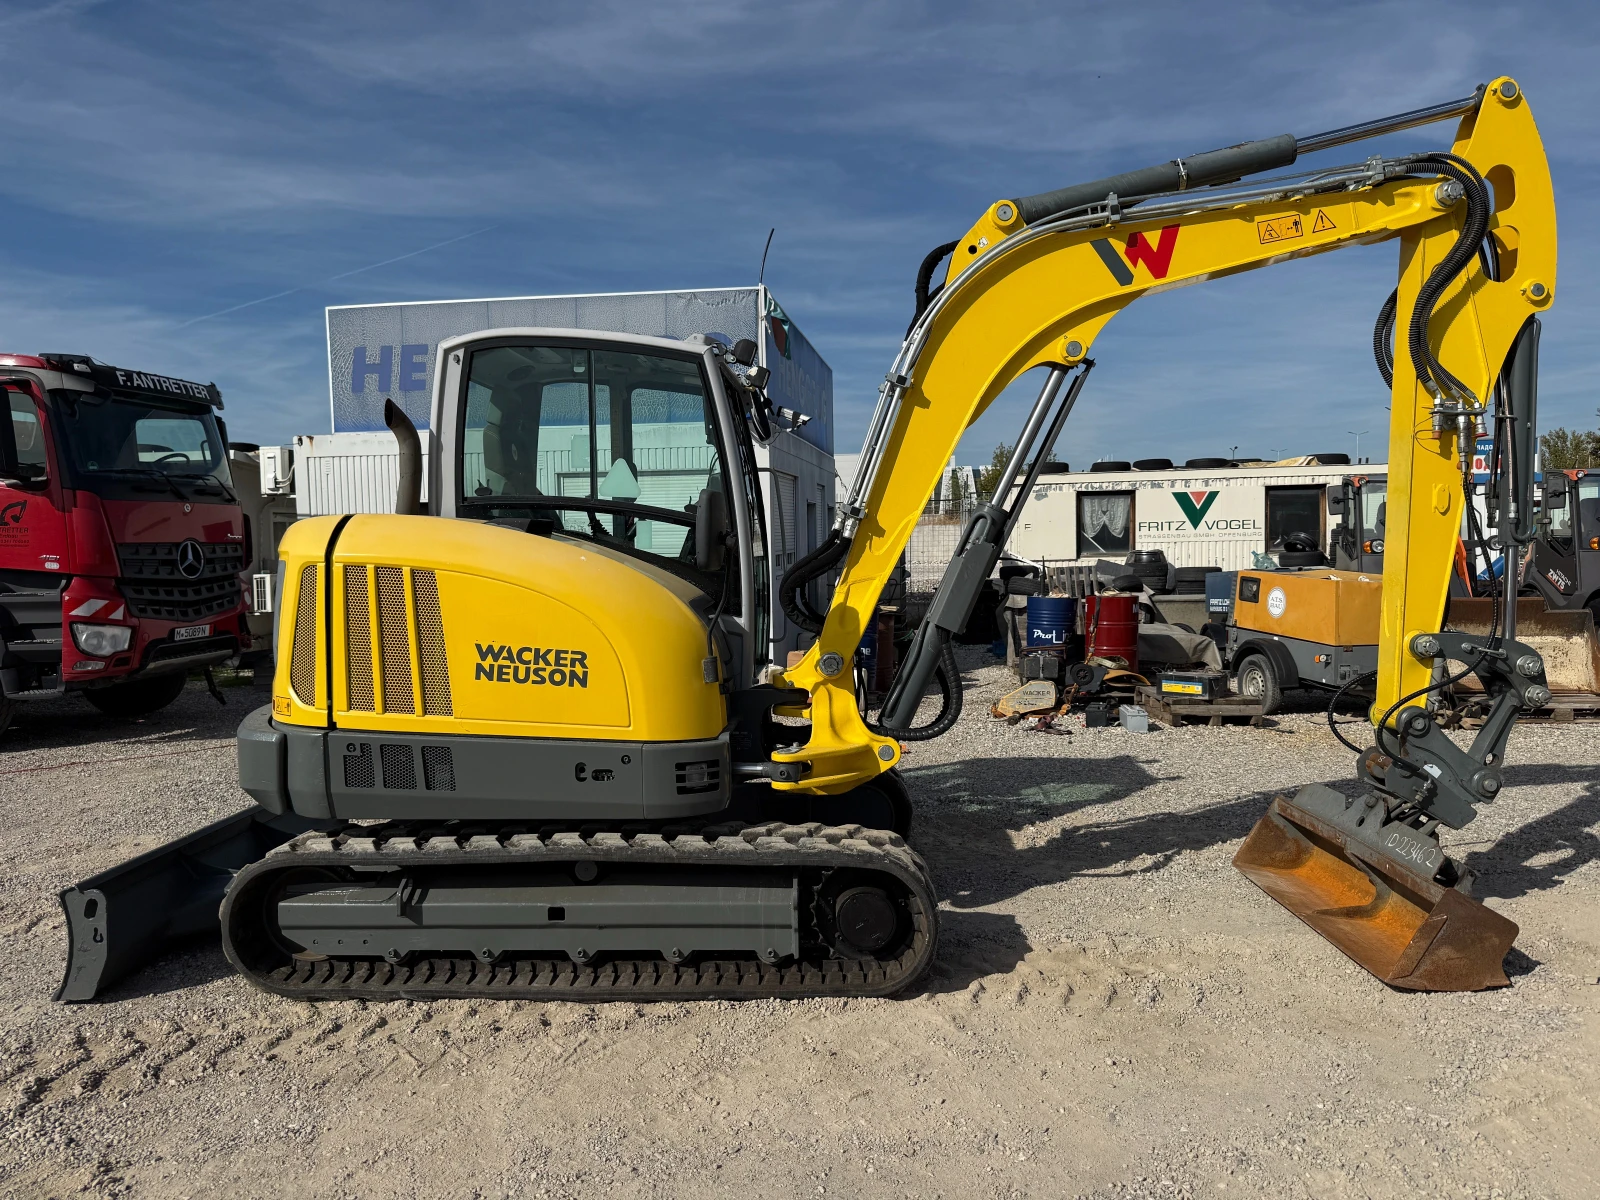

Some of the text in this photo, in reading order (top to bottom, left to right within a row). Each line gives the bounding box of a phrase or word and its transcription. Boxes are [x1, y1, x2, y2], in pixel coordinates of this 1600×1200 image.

[350, 343, 442, 394] HE
[116, 371, 210, 399] F. ANTRETTER
[1138, 519, 1262, 531] FRITZ VOGEL
[1547, 568, 1565, 590] ZW75
[1556, 569, 1571, 586] HITACHI
[475, 643, 589, 669] WACKER
[475, 662, 588, 688] NEUSON
